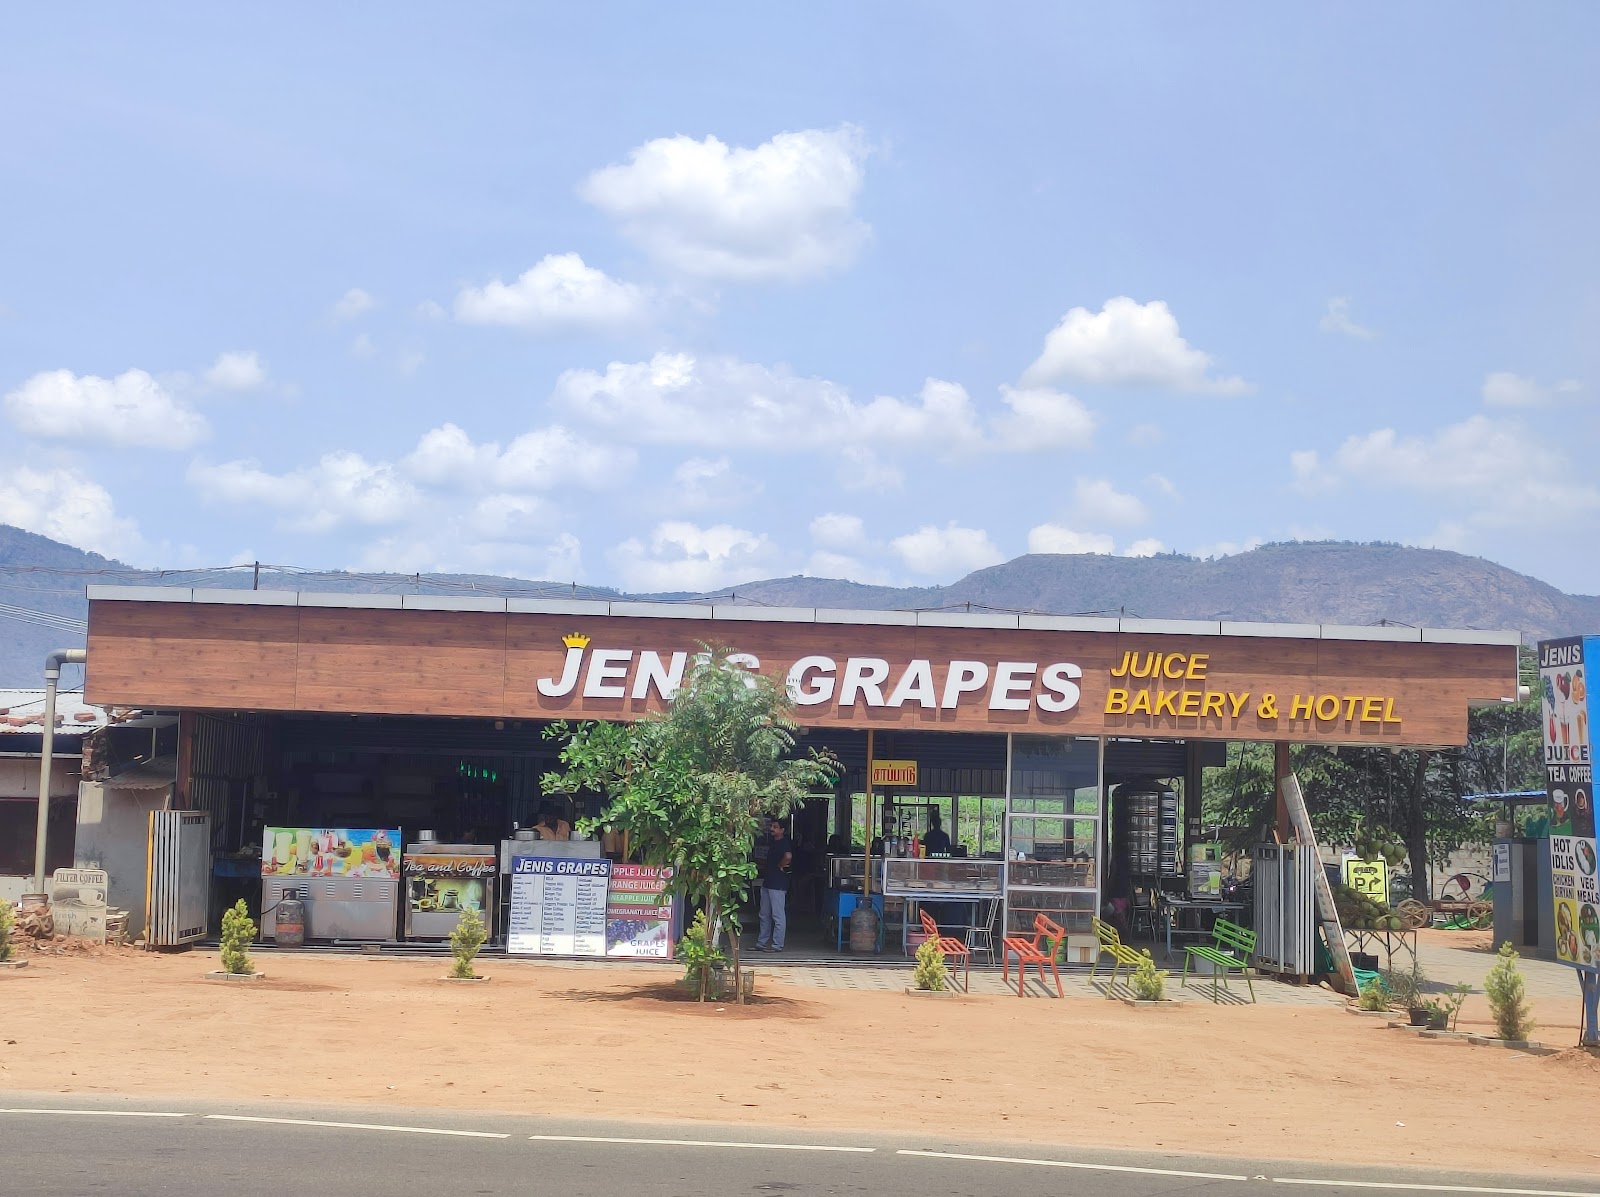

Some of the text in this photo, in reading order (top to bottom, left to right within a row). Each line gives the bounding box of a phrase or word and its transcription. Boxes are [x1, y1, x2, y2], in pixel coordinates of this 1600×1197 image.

[1541, 645, 1581, 667] JENIS
[1110, 651, 1210, 679] JUICE
[785, 655, 1082, 712] GRAPES
[1104, 689, 1403, 723] BAKERY & HOTEL
[1547, 745, 1589, 761] JUICE
[874, 764, 916, 784] சாப்பாடு
[1548, 766, 1592, 783] TEA COFFEE
[1553, 838, 1571, 853] HOT
[403, 860, 496, 876] Tea and Coffee
[515, 859, 608, 875] JENIS GRAPES
[1552, 854, 1575, 871] IDLIS
[611, 867, 635, 876] PPLE
[610, 880, 638, 889] RANGE
[1553, 874, 1575, 886] CHICKEN
[1580, 876, 1595, 890] VEG
[641, 895, 657, 903] JUIC
[1577, 890, 1600, 905] MEALS
[607, 908, 643, 916] OMEGRANATE
[630, 939, 666, 947] GRAPES
[635, 948, 660, 956] JUICE
